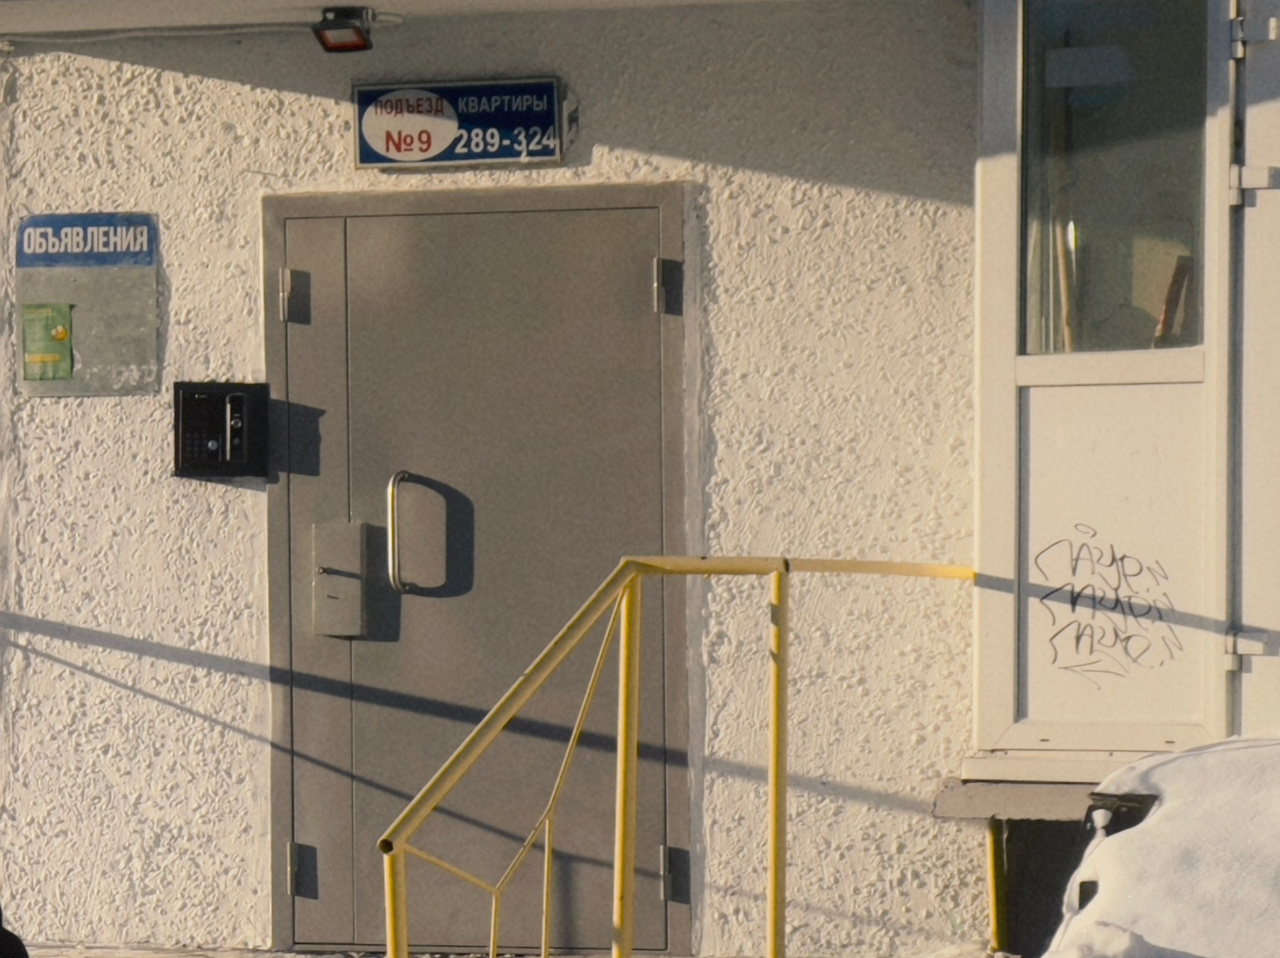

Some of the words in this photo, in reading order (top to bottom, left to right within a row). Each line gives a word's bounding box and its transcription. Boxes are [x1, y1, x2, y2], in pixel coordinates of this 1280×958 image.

[374, 97, 445, 117] ПОДЪЕЗД
[457, 94, 548, 114] КВАРТИРЫ
[454, 125, 555, 154] 289-324
[23, 225, 149, 254] ОБЪЯВЛЕНИЯ
